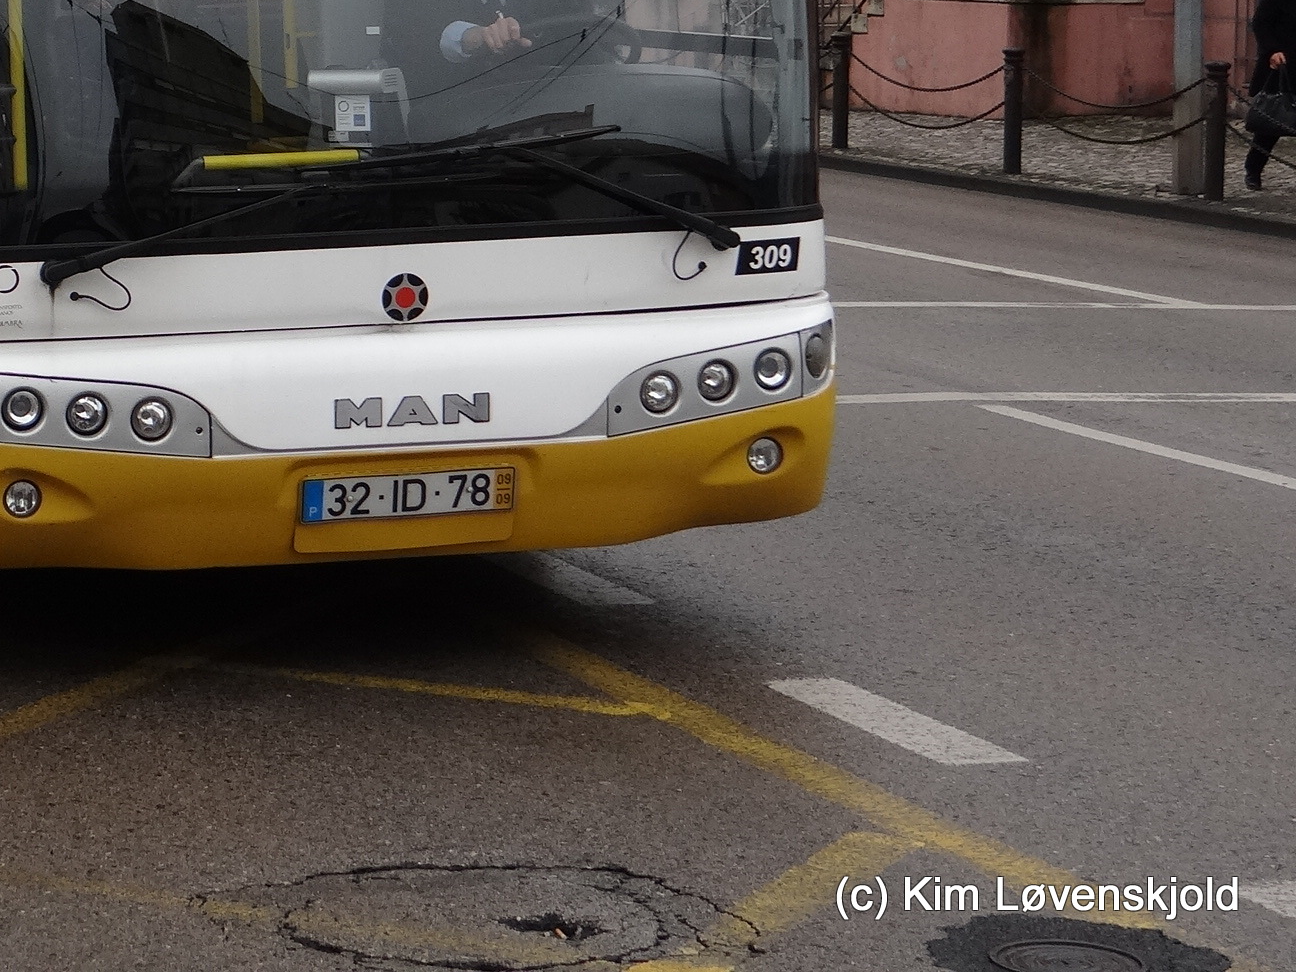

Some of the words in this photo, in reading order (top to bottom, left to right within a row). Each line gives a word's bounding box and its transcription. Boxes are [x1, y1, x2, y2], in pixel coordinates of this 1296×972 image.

[749, 244, 792, 270] 309
[335, 392, 490, 429] MAN
[496, 473, 512, 486] 09
[495, 492, 511, 505] 09
